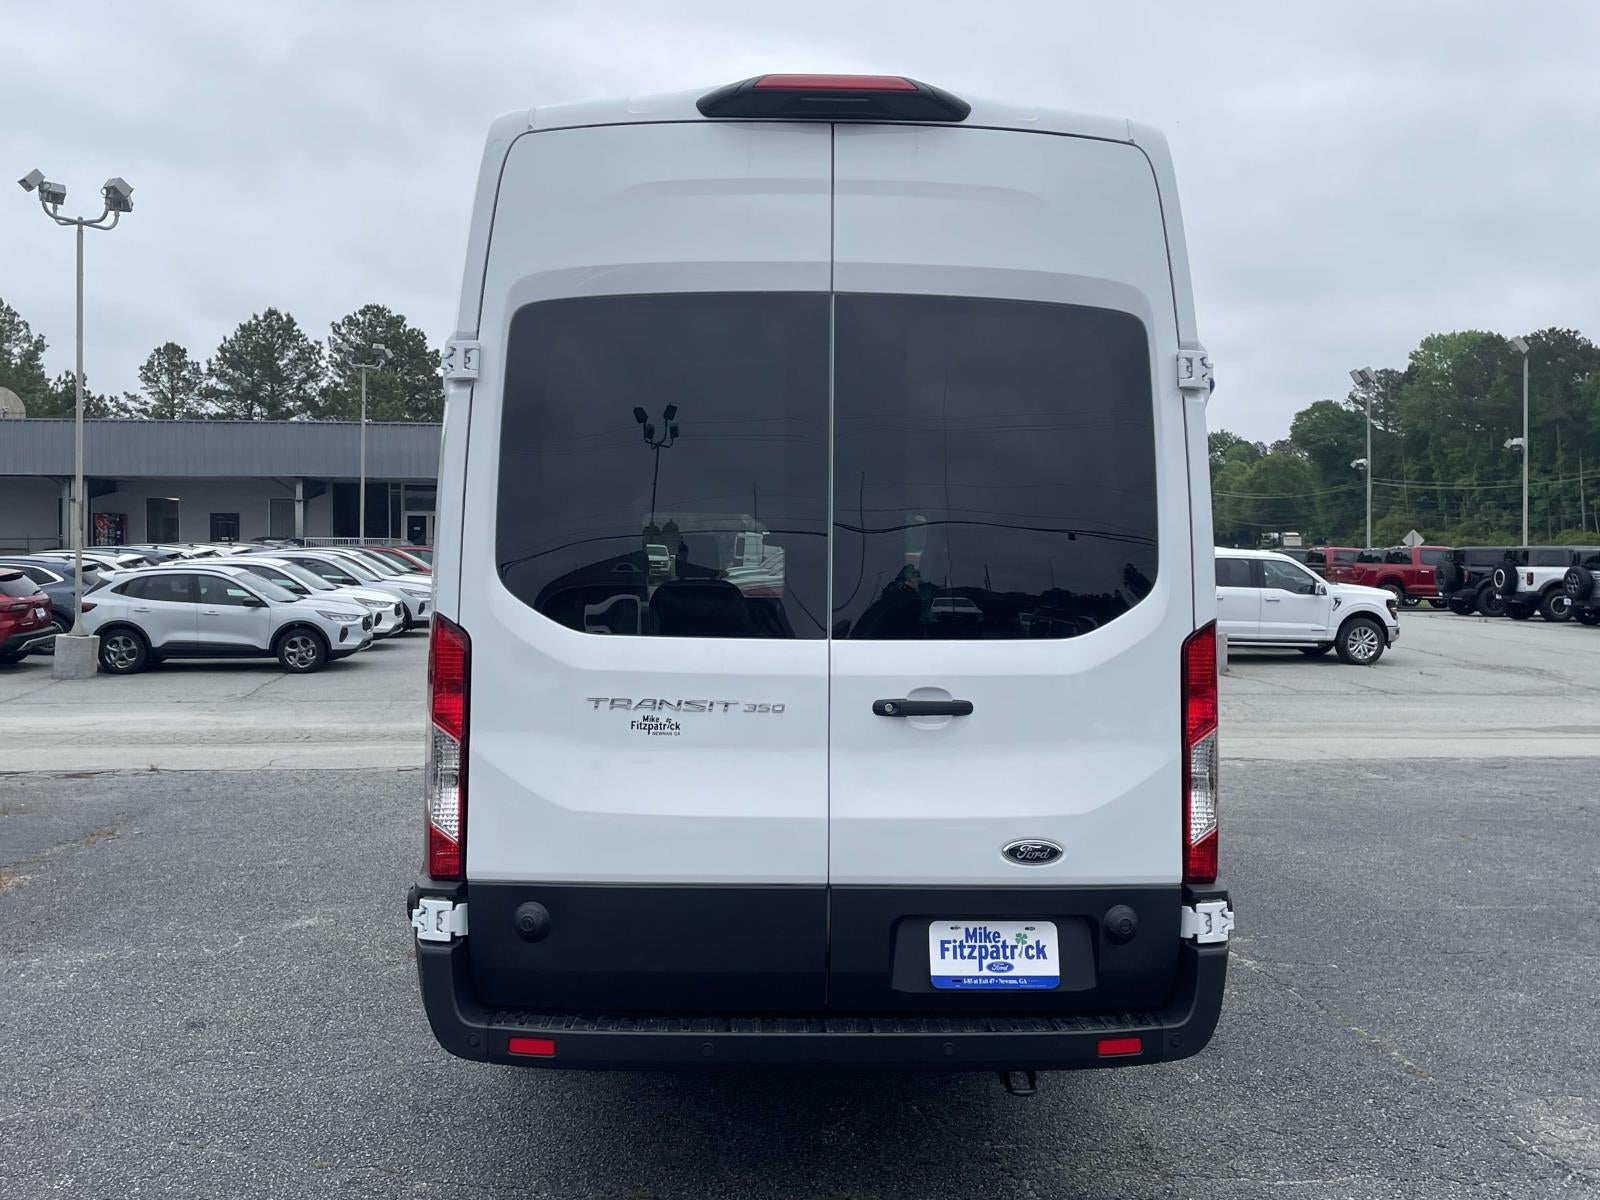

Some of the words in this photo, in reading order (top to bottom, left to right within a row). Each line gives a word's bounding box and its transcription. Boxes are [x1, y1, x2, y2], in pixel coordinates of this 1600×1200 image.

[586, 697, 739, 713] TRANSIT
[743, 703, 786, 714] 350
[642, 714, 660, 723] Mike
[1016, 844, 1051, 859] Ford
[964, 926, 1001, 944] Mike
[939, 932, 1048, 972] Fitzpatrick
